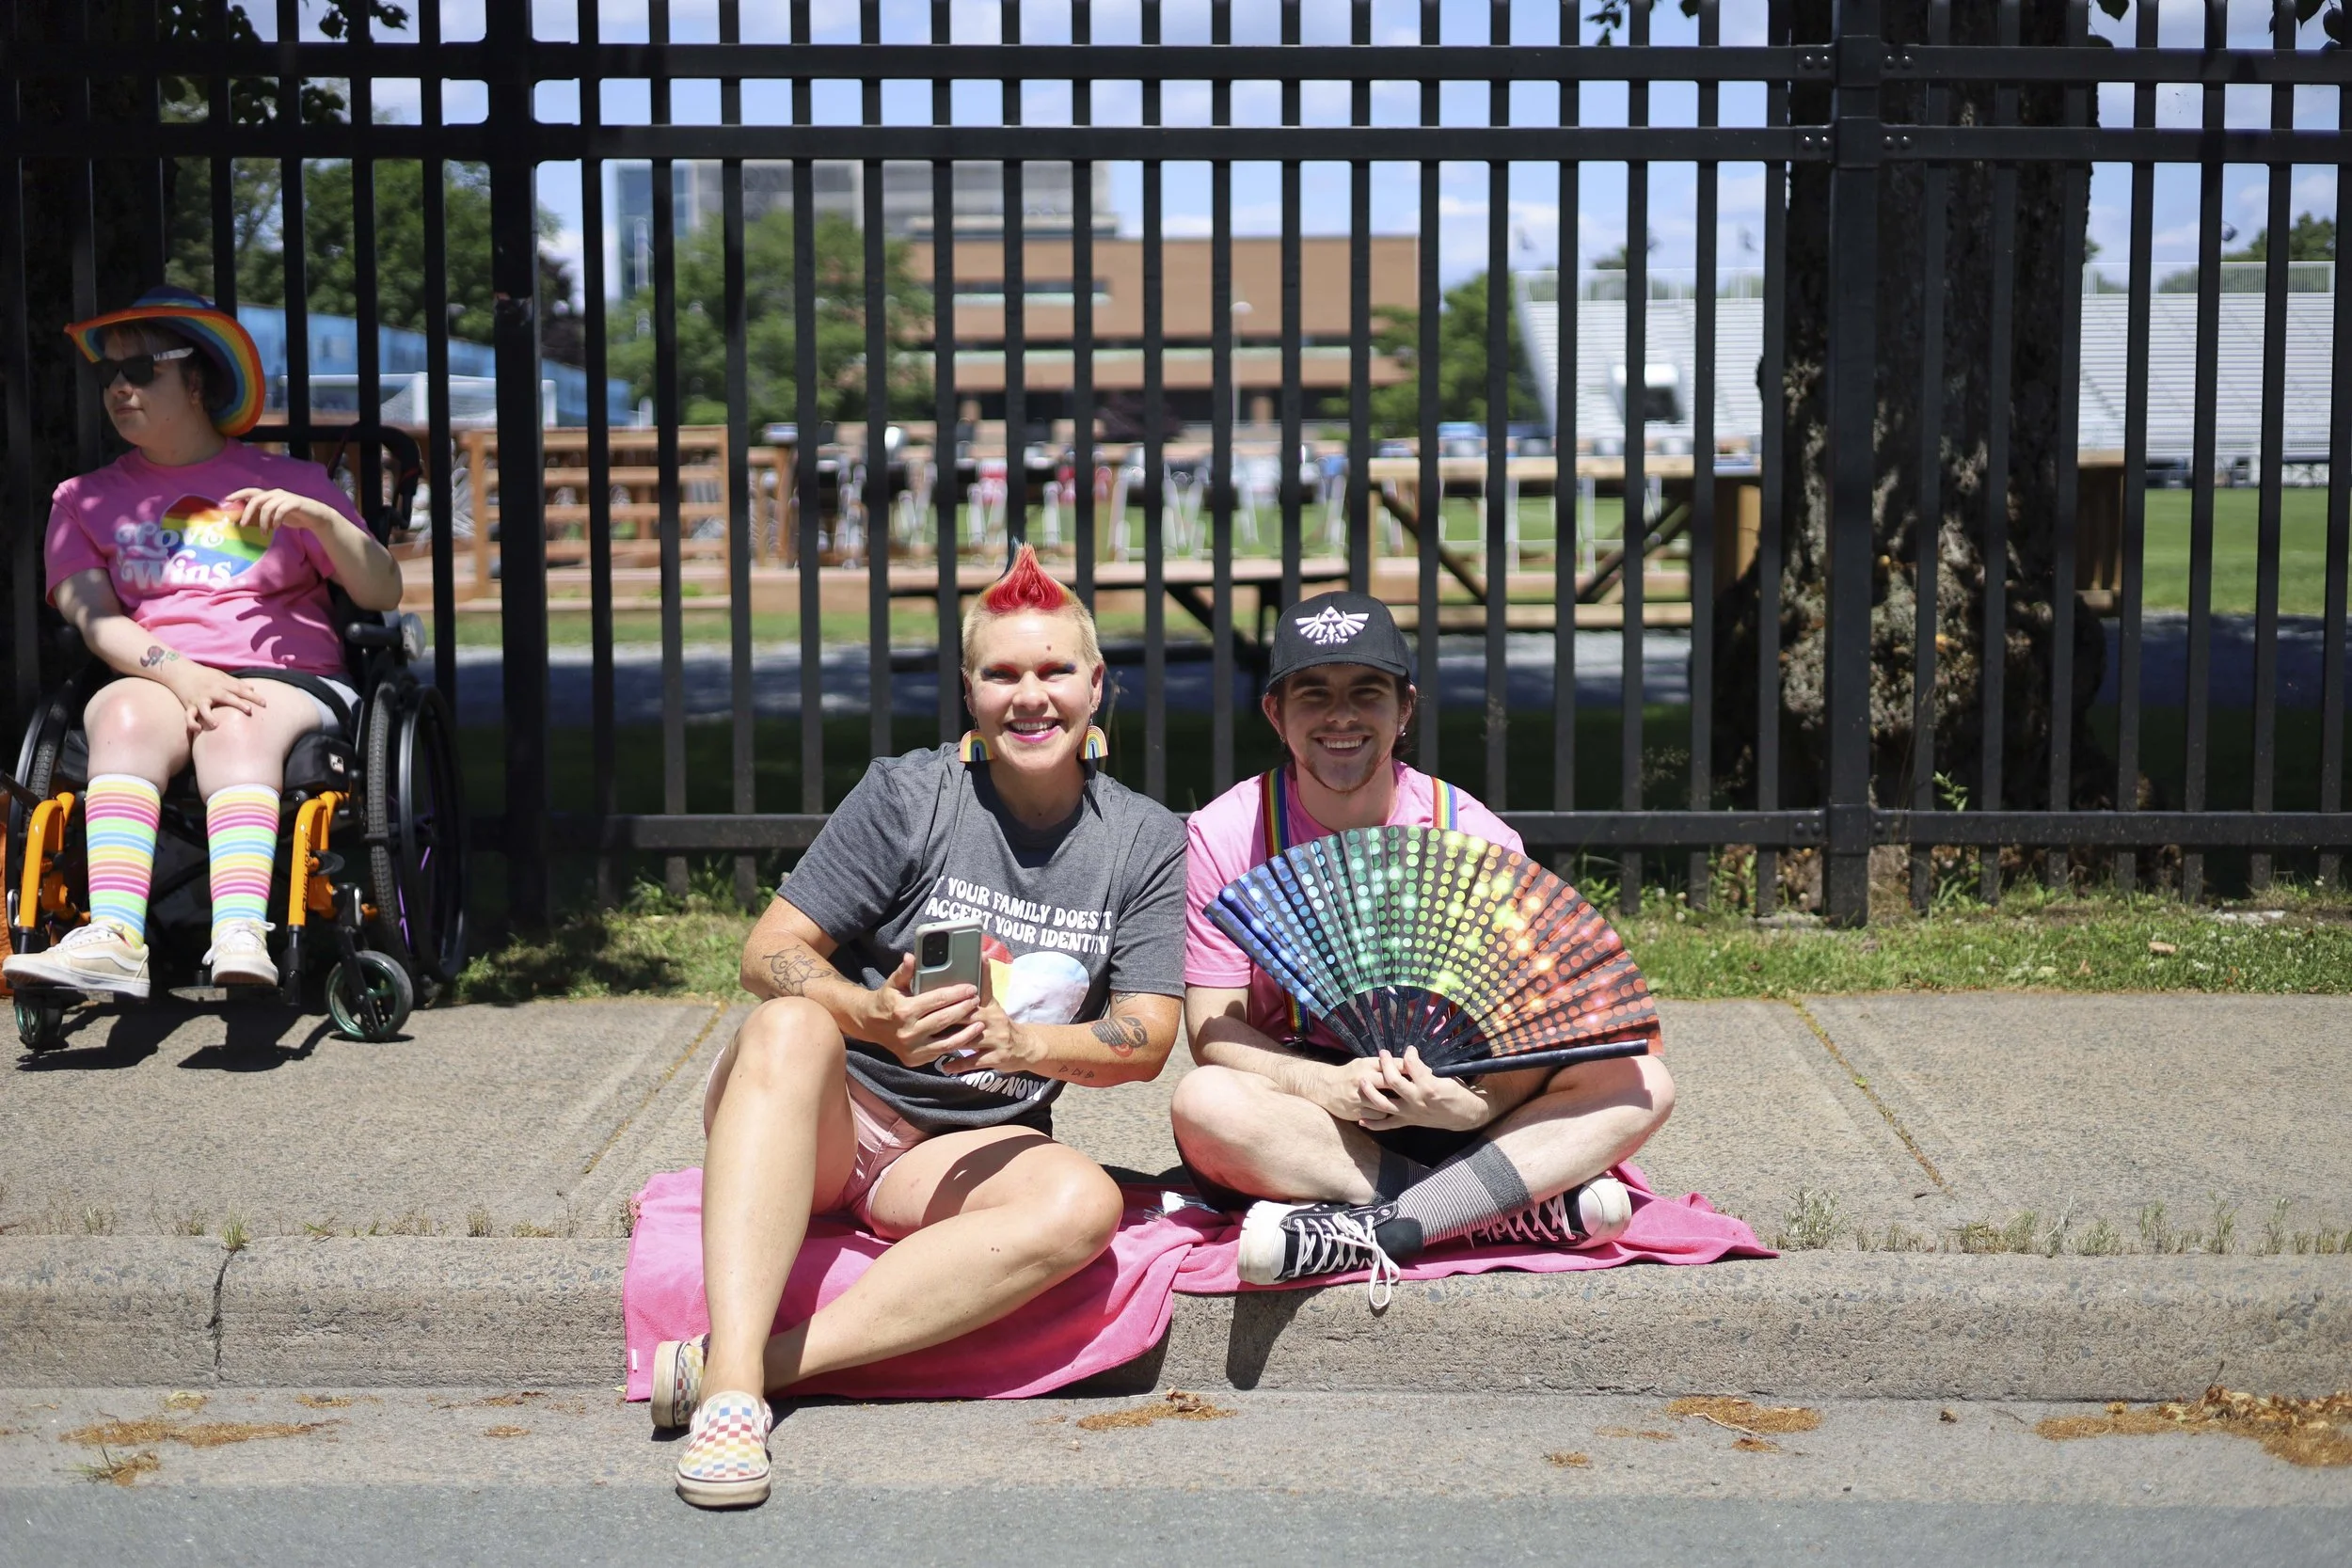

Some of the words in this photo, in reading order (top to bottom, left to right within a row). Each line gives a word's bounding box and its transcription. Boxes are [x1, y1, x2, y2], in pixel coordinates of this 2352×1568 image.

[114, 515, 230, 558] Love
[925, 896, 993, 930] ACCEPT
[995, 915, 1037, 944] YOUR
[948, 877, 991, 907] YOUR
[993, 891, 1052, 925] FAMILY
